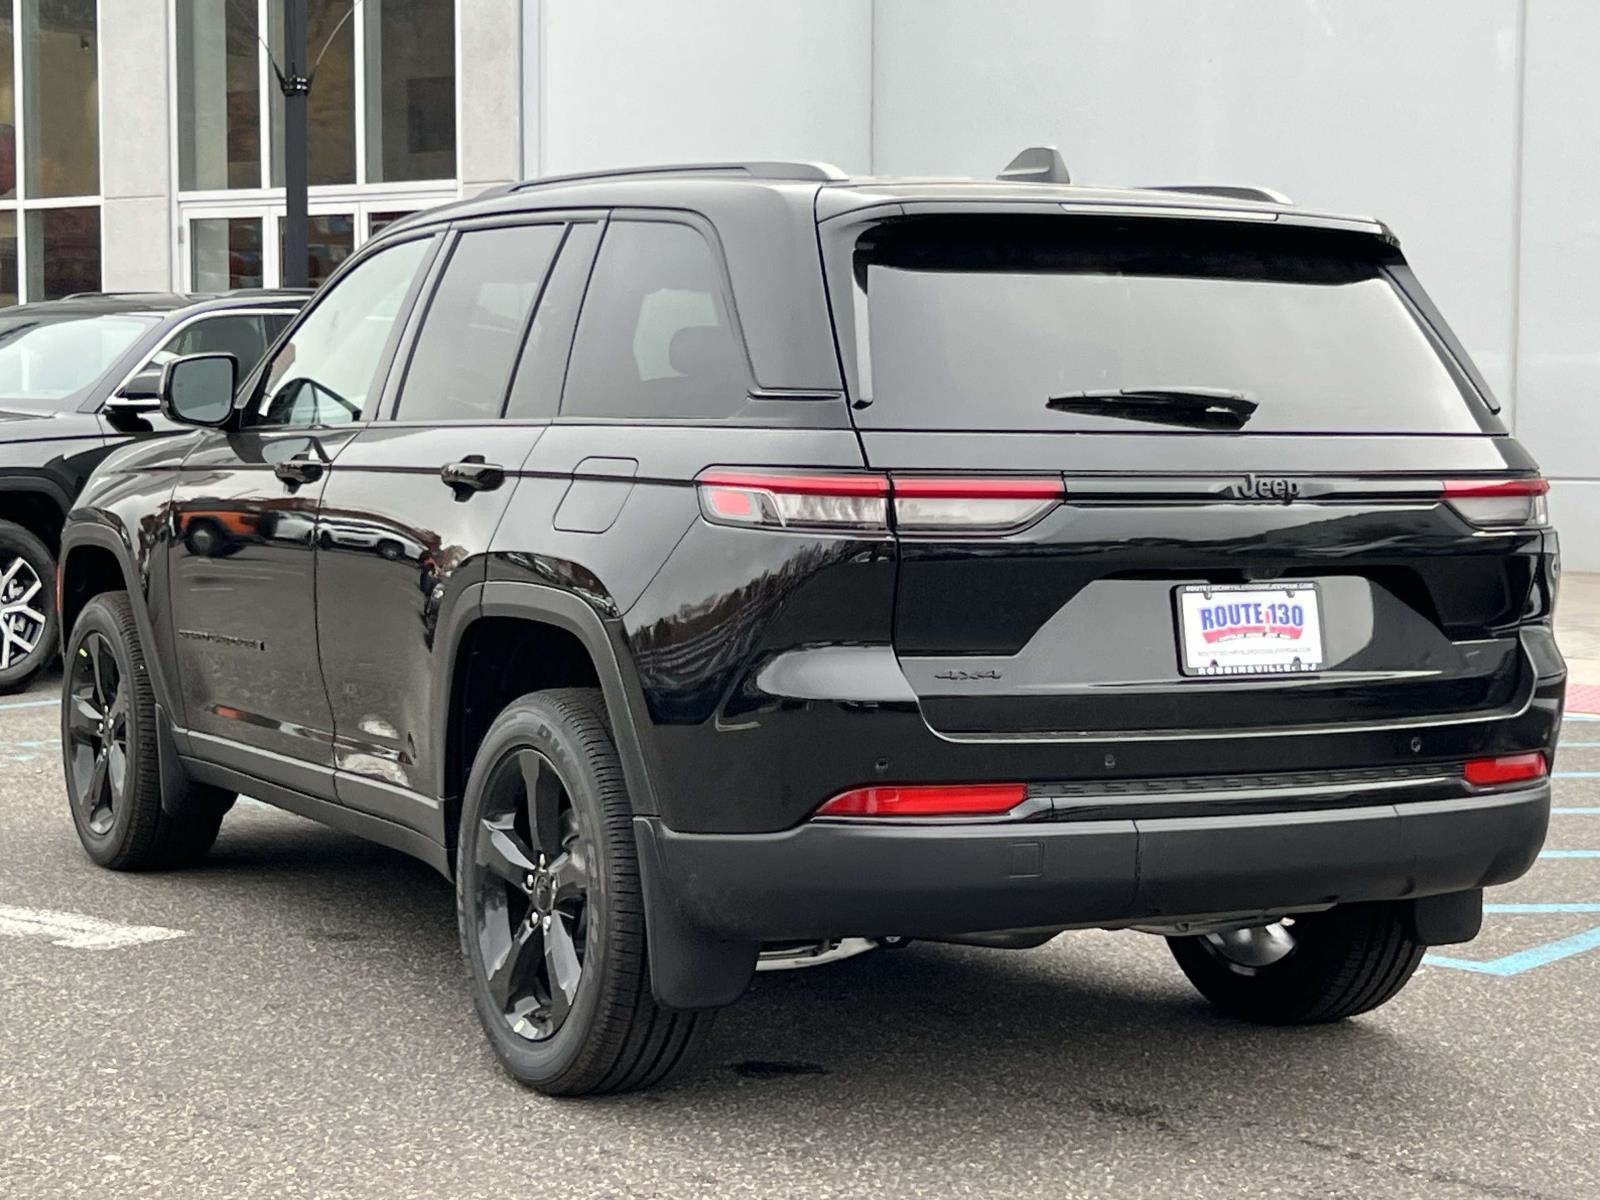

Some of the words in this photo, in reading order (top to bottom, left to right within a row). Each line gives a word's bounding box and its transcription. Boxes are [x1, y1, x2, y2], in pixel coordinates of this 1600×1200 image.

[1229, 473, 1300, 505] Jeep
[1200, 603, 1264, 630] ROUTE
[1267, 603, 1304, 626] 130
